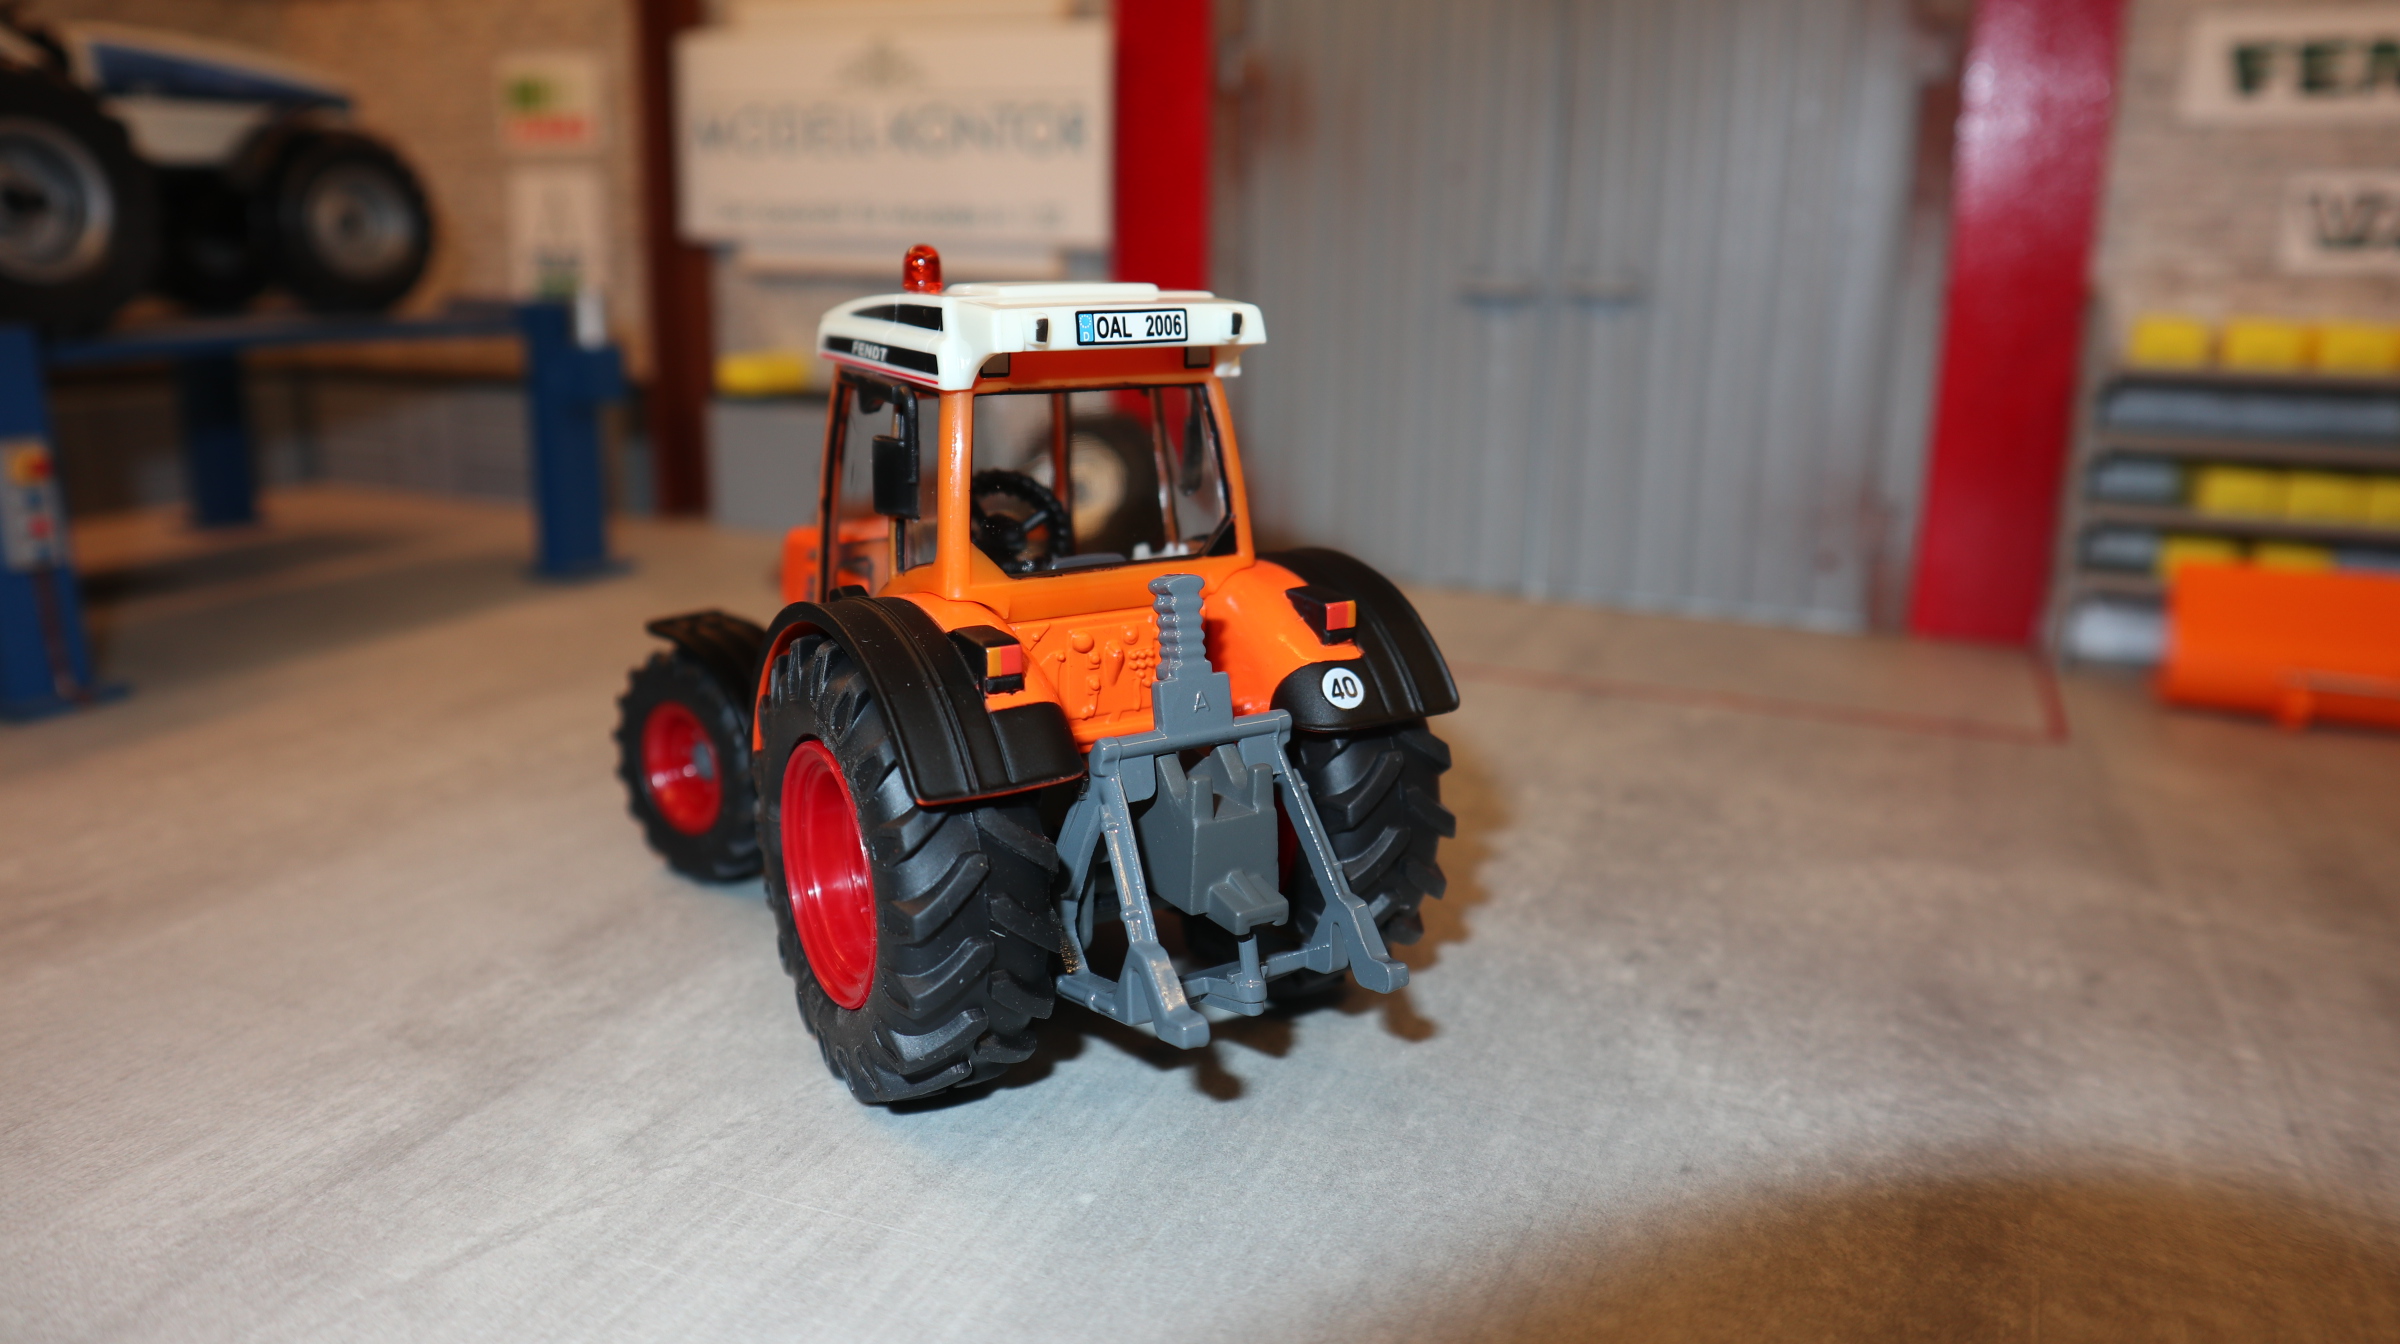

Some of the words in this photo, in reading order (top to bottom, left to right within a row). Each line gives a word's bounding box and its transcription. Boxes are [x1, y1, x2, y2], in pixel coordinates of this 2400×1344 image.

[1097, 316, 1132, 338] OAL
[1145, 314, 1182, 337] 2006
[851, 340, 888, 362] FENDT
[1331, 676, 1358, 700] 40
[1193, 690, 1211, 713] A
